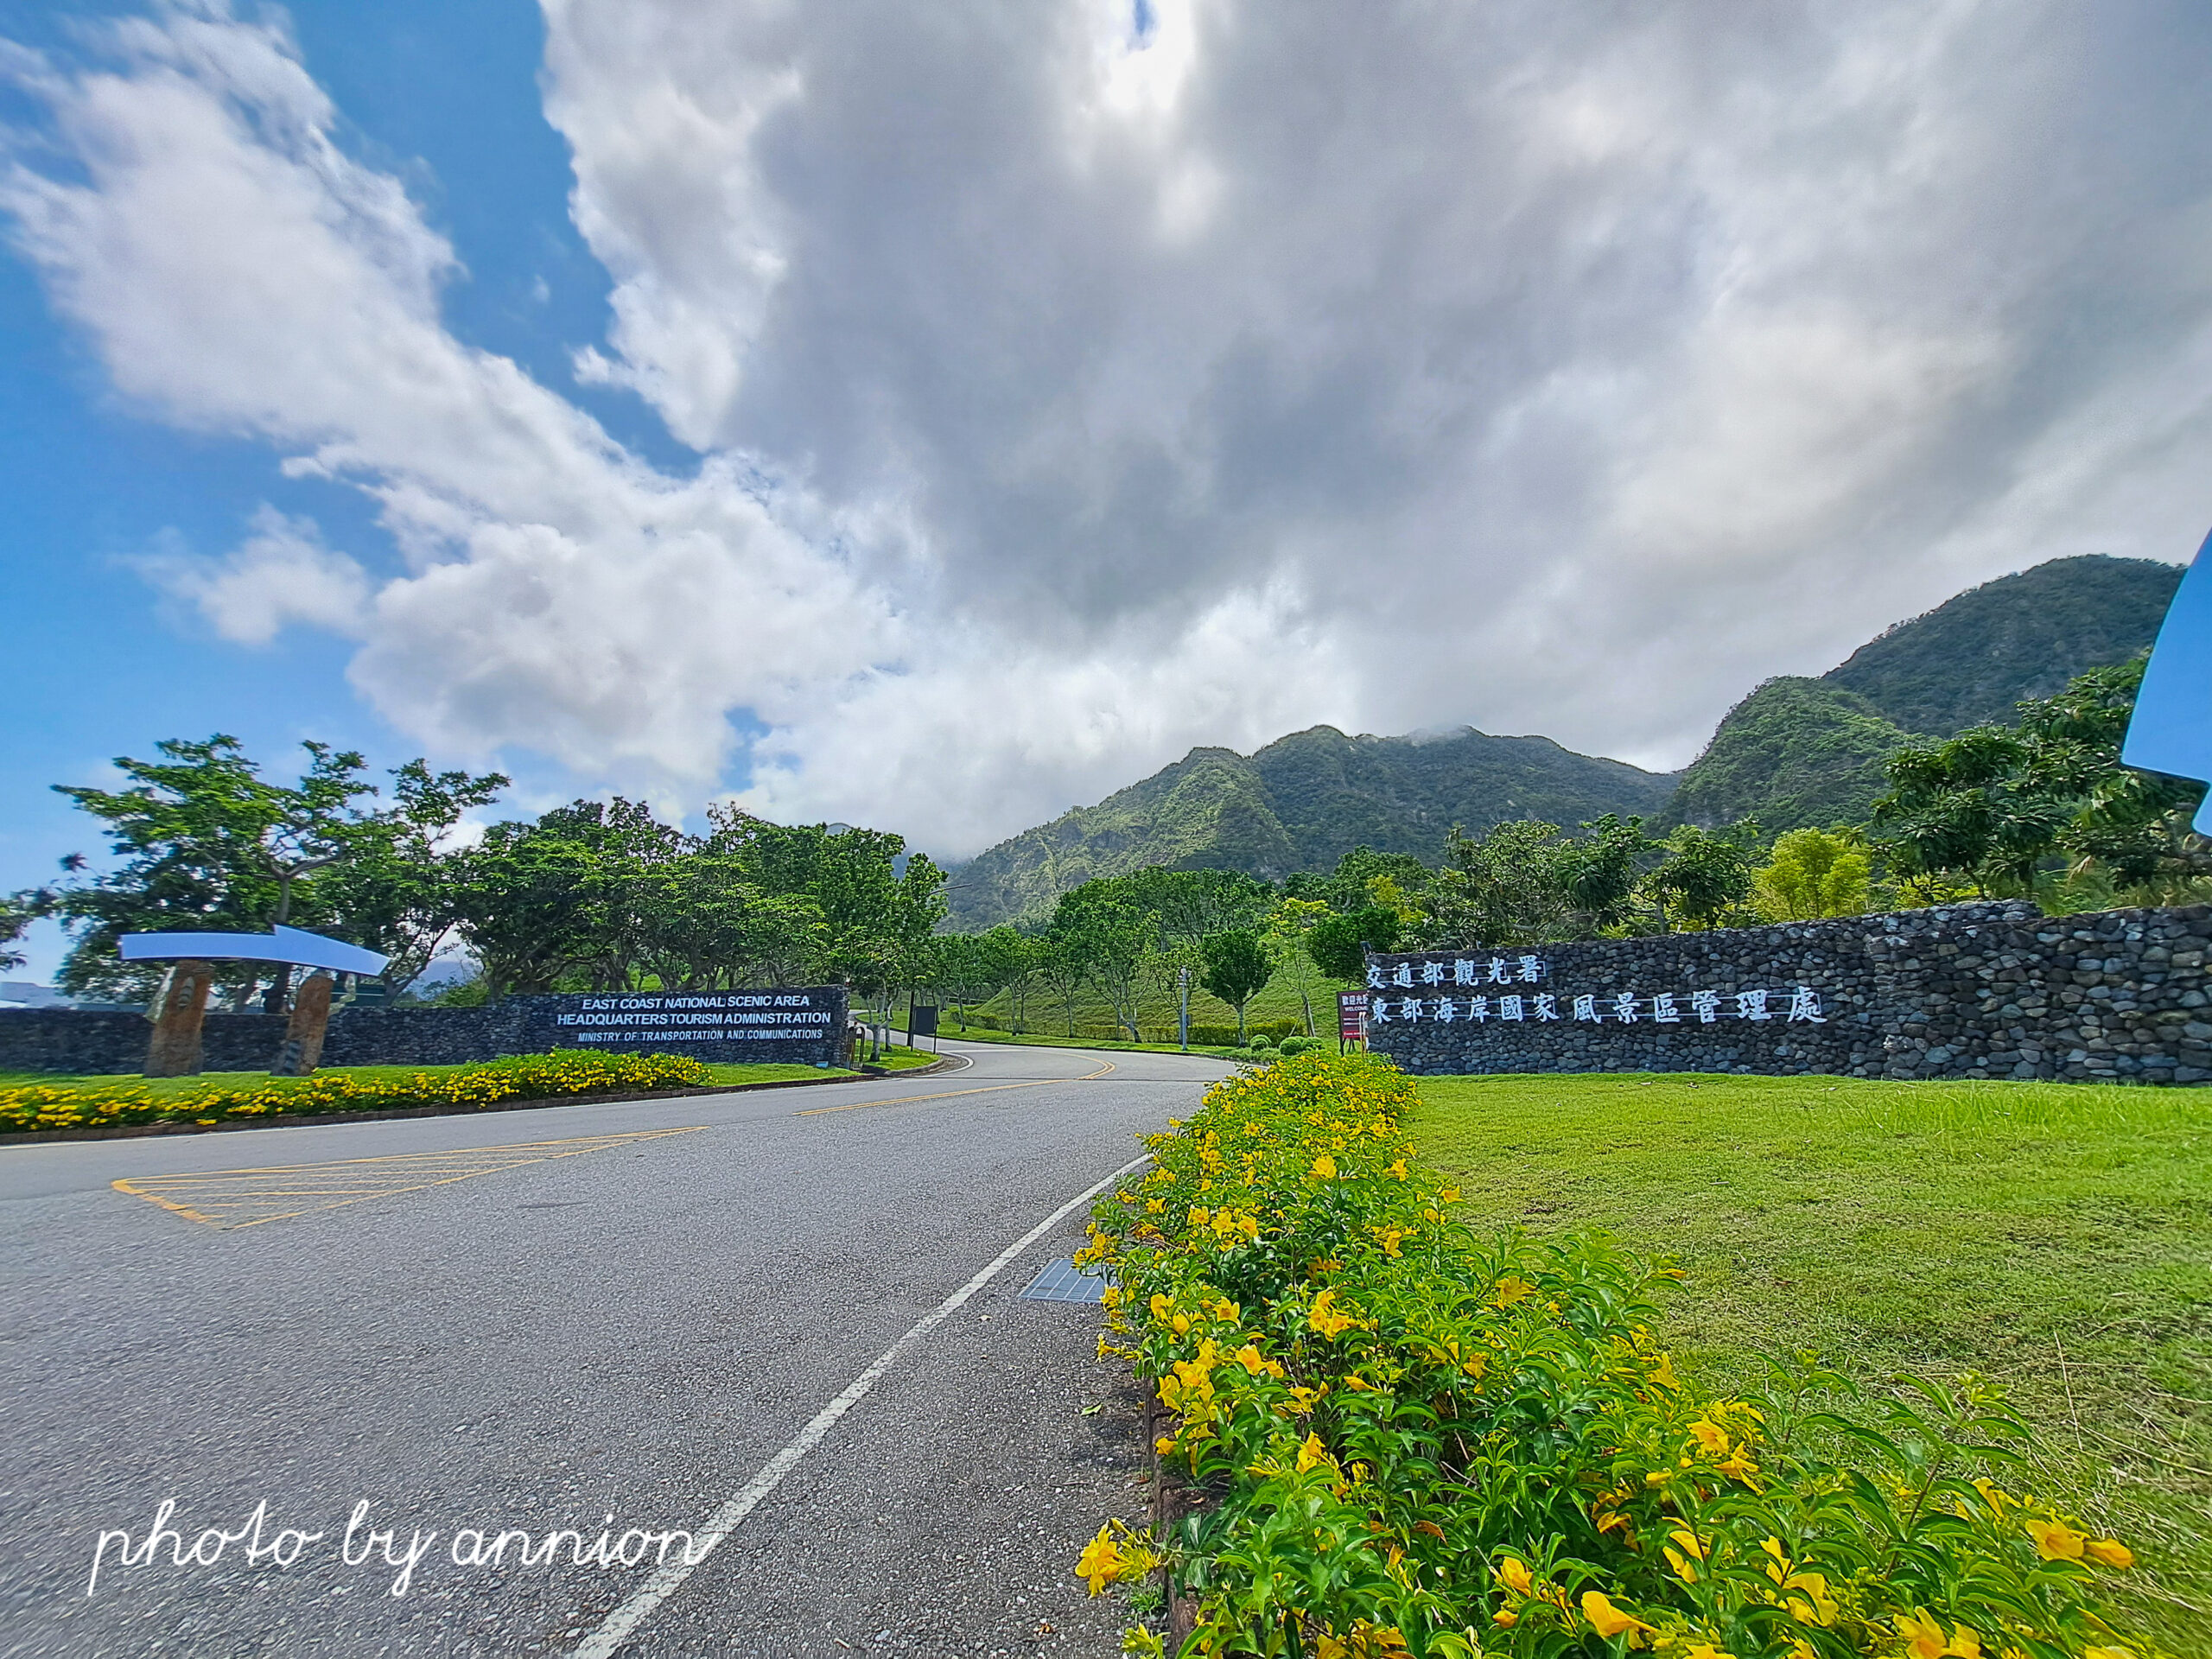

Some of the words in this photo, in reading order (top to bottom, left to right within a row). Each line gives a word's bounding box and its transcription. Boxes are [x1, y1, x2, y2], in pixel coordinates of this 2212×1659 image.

[1365, 955, 1543, 989] 交通部觀光署
[582, 998, 618, 1010] EAST
[620, 997, 663, 1009] COAST
[664, 996, 725, 1009] NATIONAL
[728, 995, 772, 1007] SCENIC
[773, 995, 810, 1007] AREA
[1370, 986, 1828, 1025] 東部海岸國家風景區管理處
[556, 1014, 668, 1026] HEADQUARTERS
[669, 1013, 723, 1025] TOURISM
[723, 1012, 831, 1025] ADMINISTRATION
[577, 1032, 620, 1042] MINISTRY
[624, 1031, 638, 1041] OF
[641, 1030, 723, 1041] TRANSPORTATION
[727, 1030, 745, 1039] AND
[747, 1029, 823, 1039] COMMUNICATIONS
